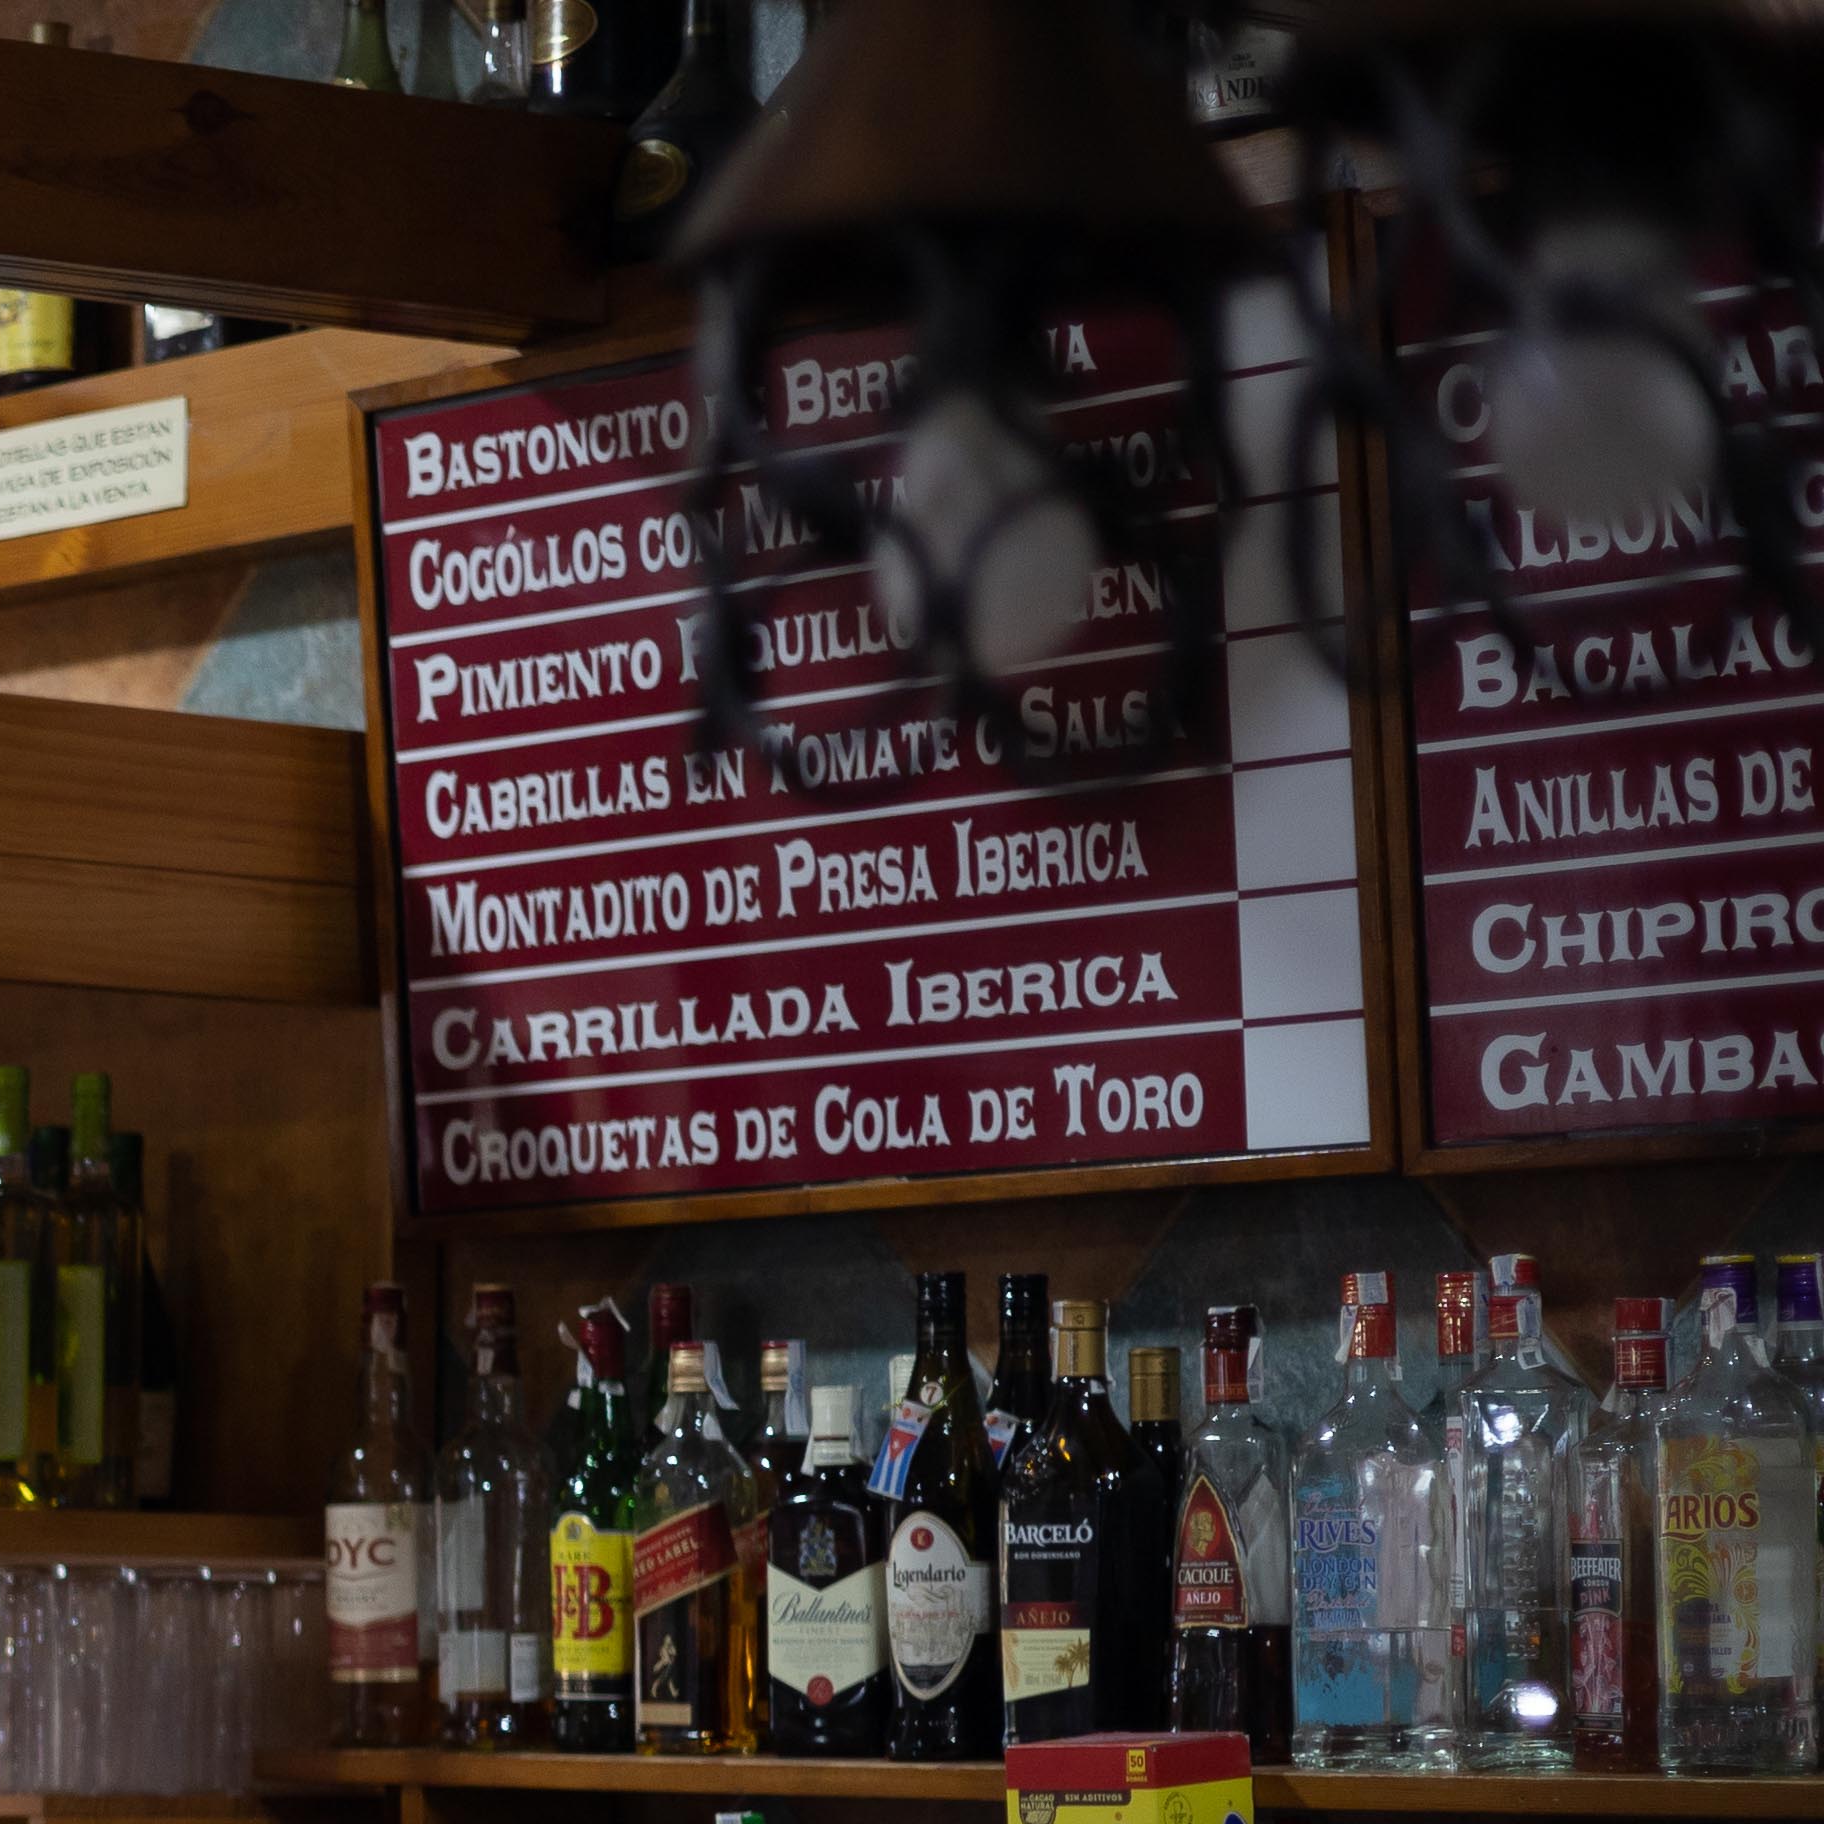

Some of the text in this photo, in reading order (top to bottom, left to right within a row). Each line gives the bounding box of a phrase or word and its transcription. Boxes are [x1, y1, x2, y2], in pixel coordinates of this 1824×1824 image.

[404, 400, 689, 499] BASTONCITO
[409, 524, 628, 611] COGÓLLOS
[413, 637, 663, 724] PIMIENTO
[425, 716, 959, 840] CABRILLAS EN TOMATE
[1464, 747, 1815, 849] ANILLAS DE
[426, 815, 1150, 958] MONTADITO DE PRESA IBERICA
[431, 951, 1180, 1073] CARRILLADA IBERICA
[441, 1062, 1205, 1188] CROQUETAS DE COLA DE TORO
[1004, 1517, 1094, 1547] BARCELÓ
[1299, 1519, 1376, 1549] RIVES
[893, 1561, 965, 1588] Legendario
[1178, 1567, 1234, 1585] CACIQUE
[1300, 1557, 1376, 1575] LONDON
[1571, 1557, 1622, 1582] BEEFEATER
[1185, 1589, 1221, 1606] AÑEJO
[1016, 1606, 1071, 1626] AÑEJO
[1130, 1755, 1144, 1769] 50
[1064, 1793, 1123, 1802] SIN ADITIVOS
